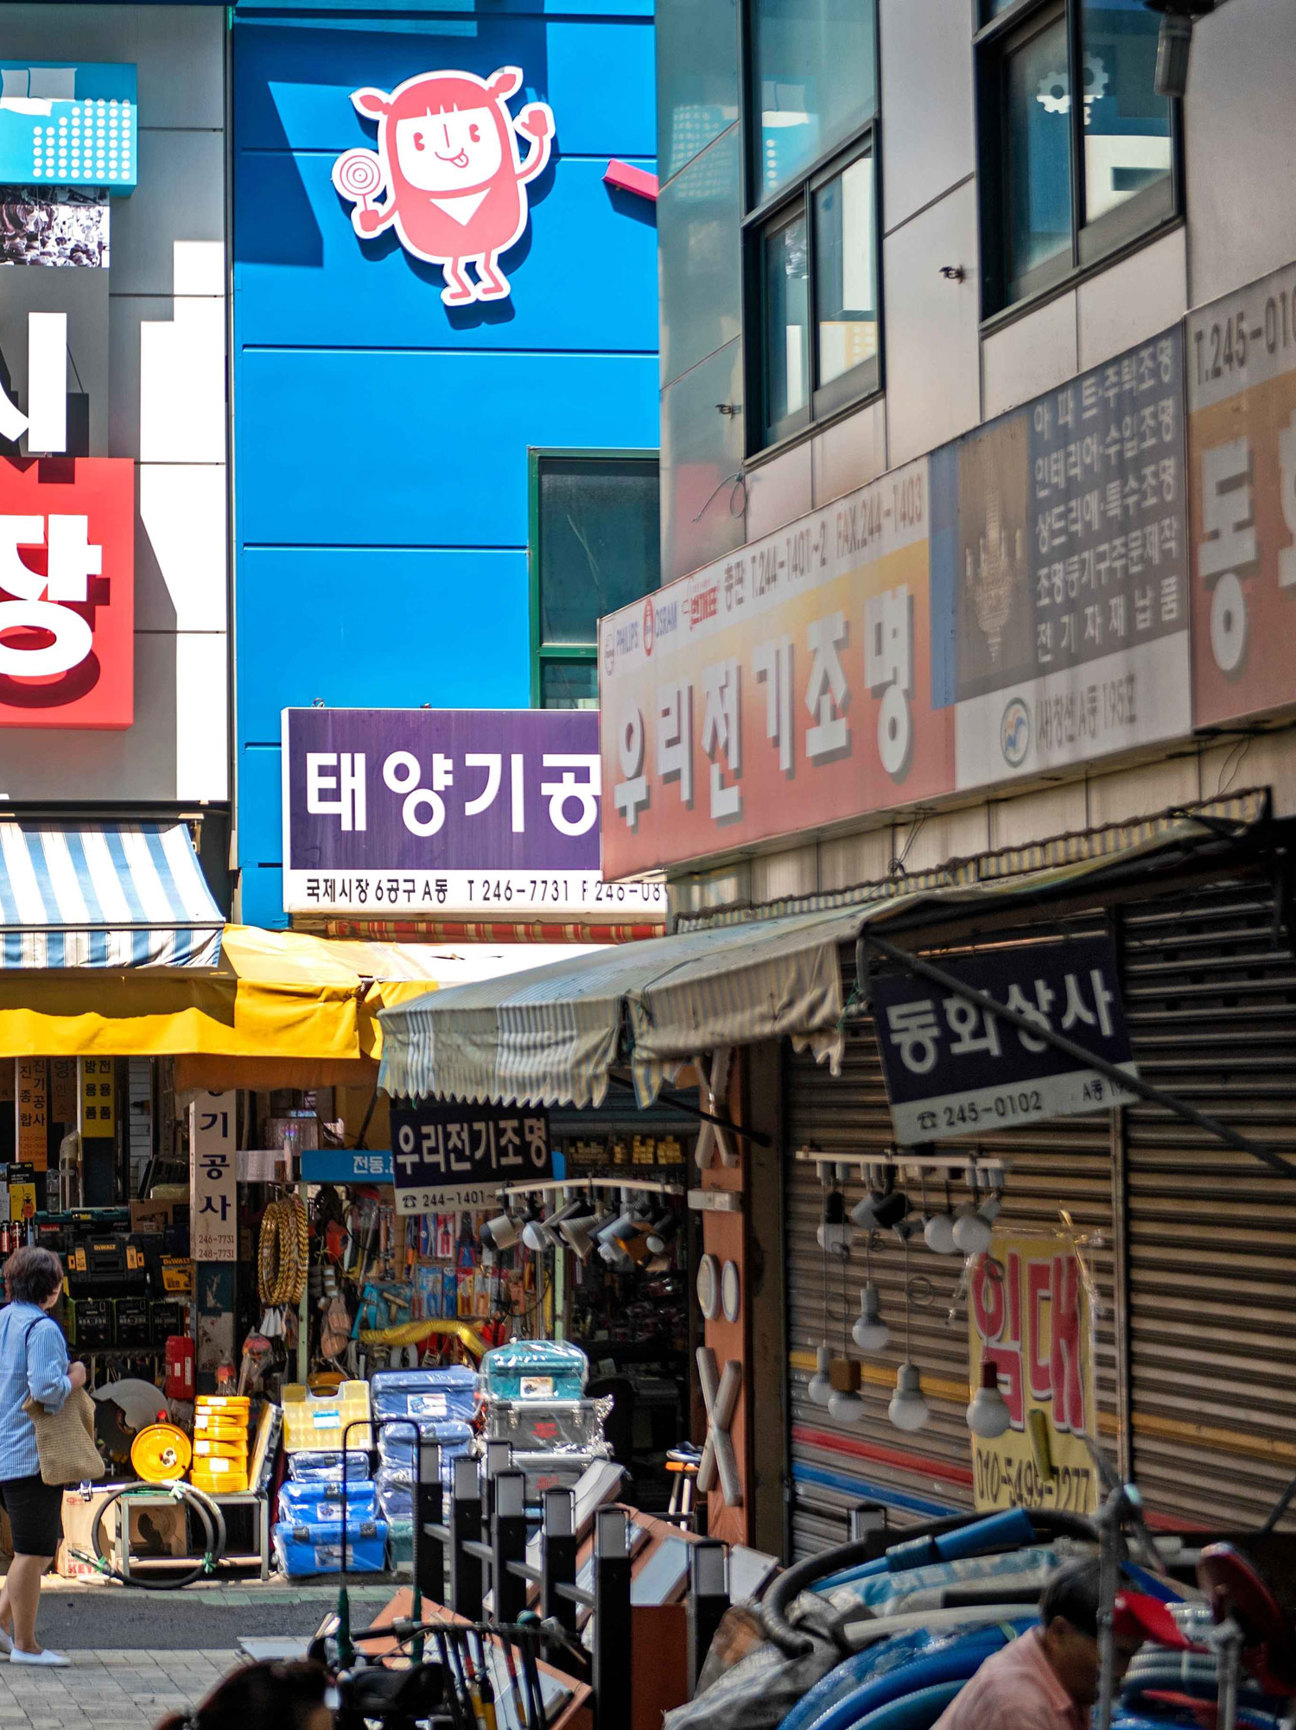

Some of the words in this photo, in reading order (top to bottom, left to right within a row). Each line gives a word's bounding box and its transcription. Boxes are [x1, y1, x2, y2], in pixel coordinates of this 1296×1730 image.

[614, 584, 912, 827] 우리전기조명
[306, 750, 601, 837] 태양기공
[306, 878, 370, 903] 국제시장
[375, 878, 416, 903] 6공구
[421, 878, 448, 903] A동
[482, 879, 570, 902] 246-7731
[943, 1091, 1042, 1126] 245-0102
[199, 1090, 232, 1222] 기공사
[396, 1116, 548, 1176] 우리전기조명
[198, 1234, 235, 1244] 246-7731
